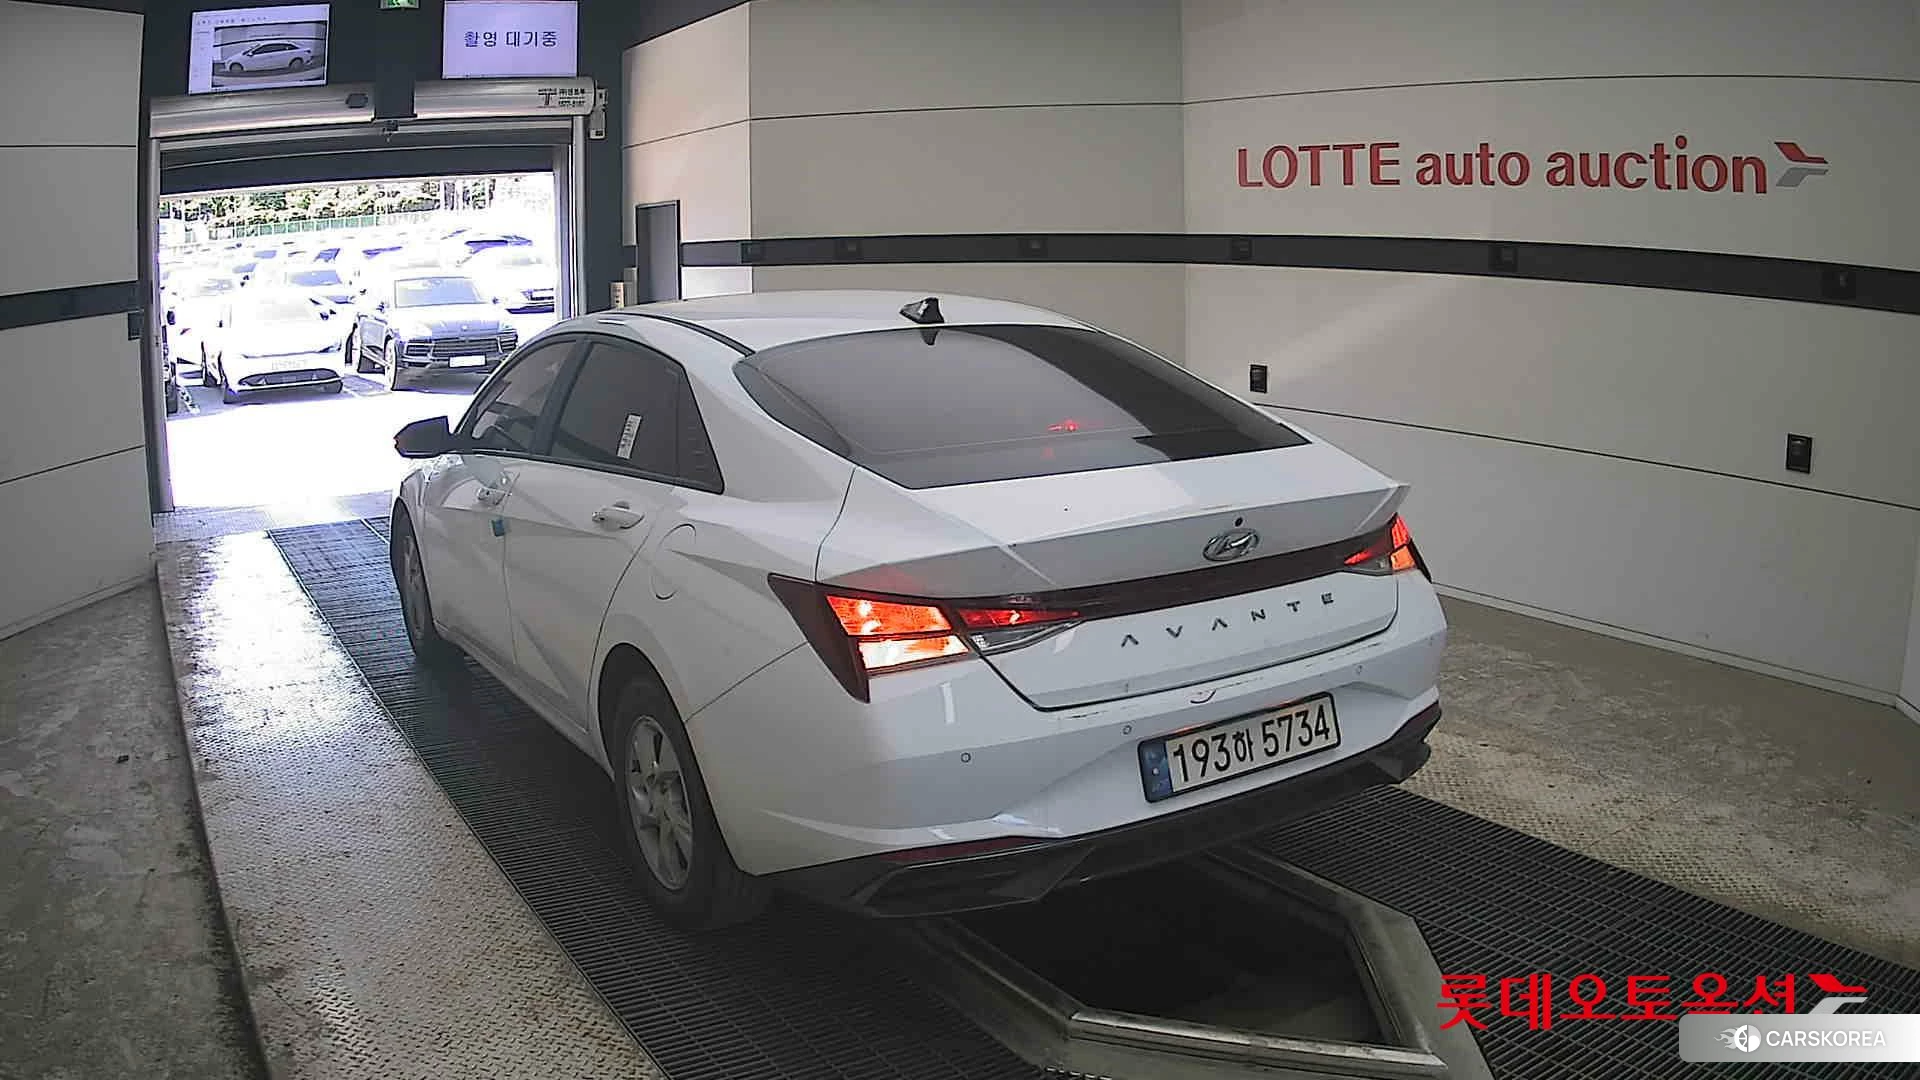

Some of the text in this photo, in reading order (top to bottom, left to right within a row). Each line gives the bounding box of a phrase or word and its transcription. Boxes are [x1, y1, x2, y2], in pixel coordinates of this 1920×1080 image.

[464, 31, 558, 48] 촬영 대기중
[1239, 137, 1767, 192] LOTTE auto auction
[1120, 592, 1336, 647] AVANTE
[1172, 704, 1331, 783] 193하 5734
